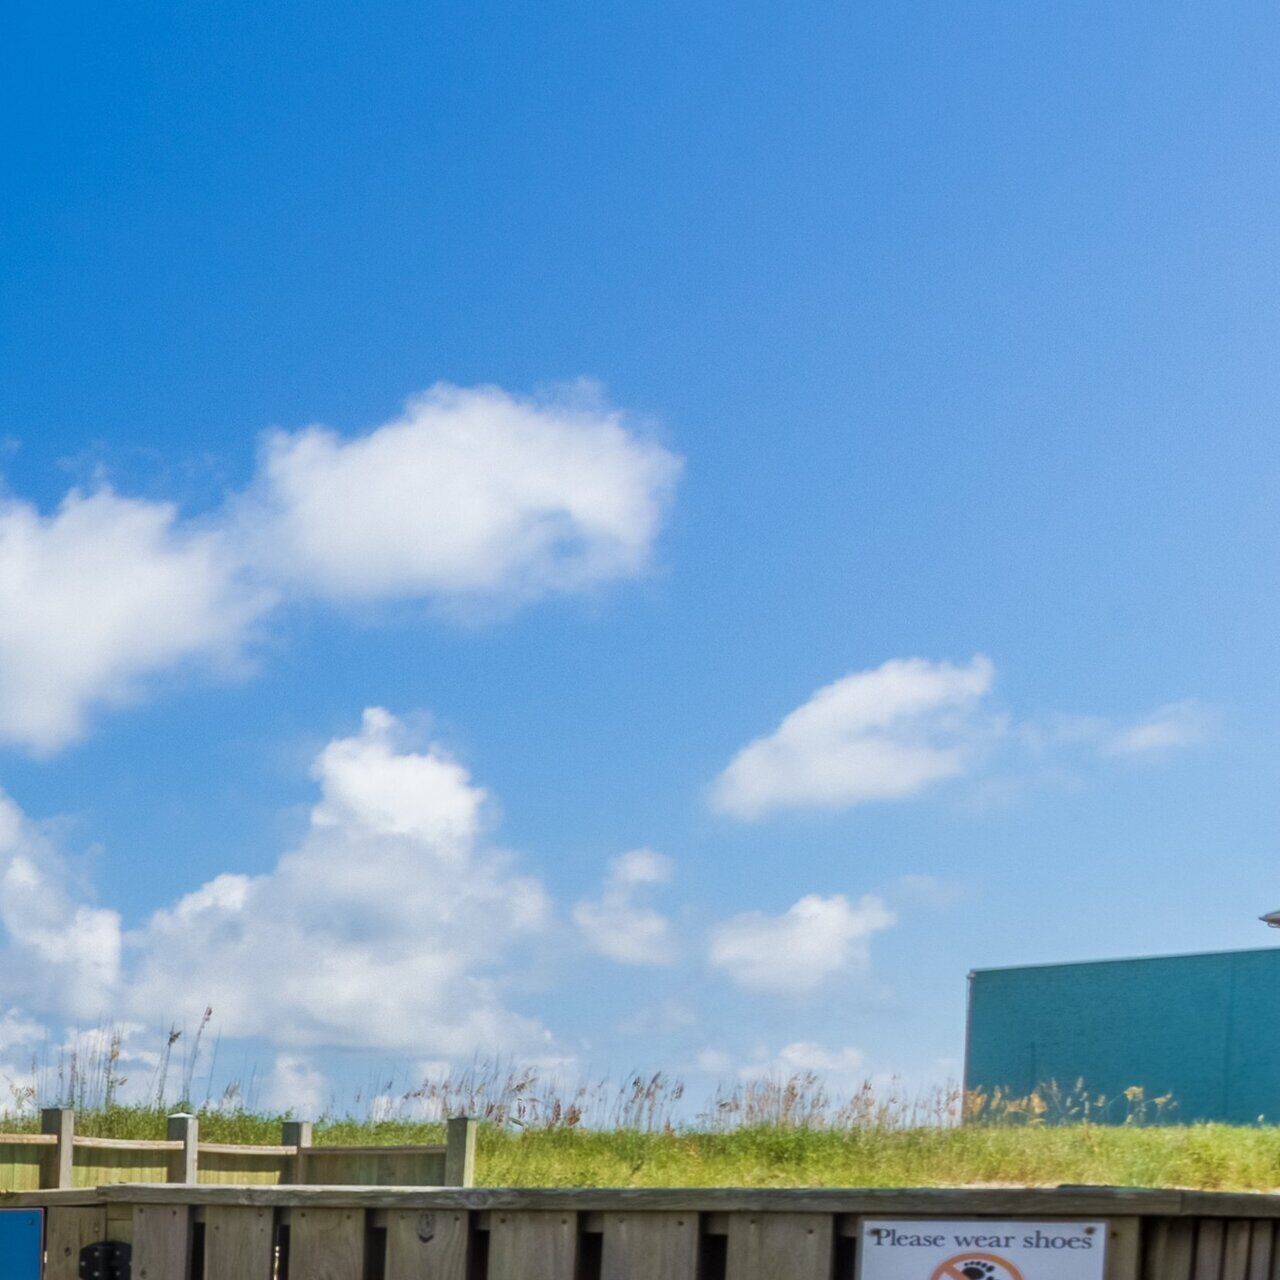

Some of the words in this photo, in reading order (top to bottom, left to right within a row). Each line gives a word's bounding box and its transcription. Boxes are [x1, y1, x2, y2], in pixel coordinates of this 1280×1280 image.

[874, 1228, 946, 1247] Please
[953, 1232, 1015, 1248] wear
[1022, 1230, 1093, 1249] shoes
